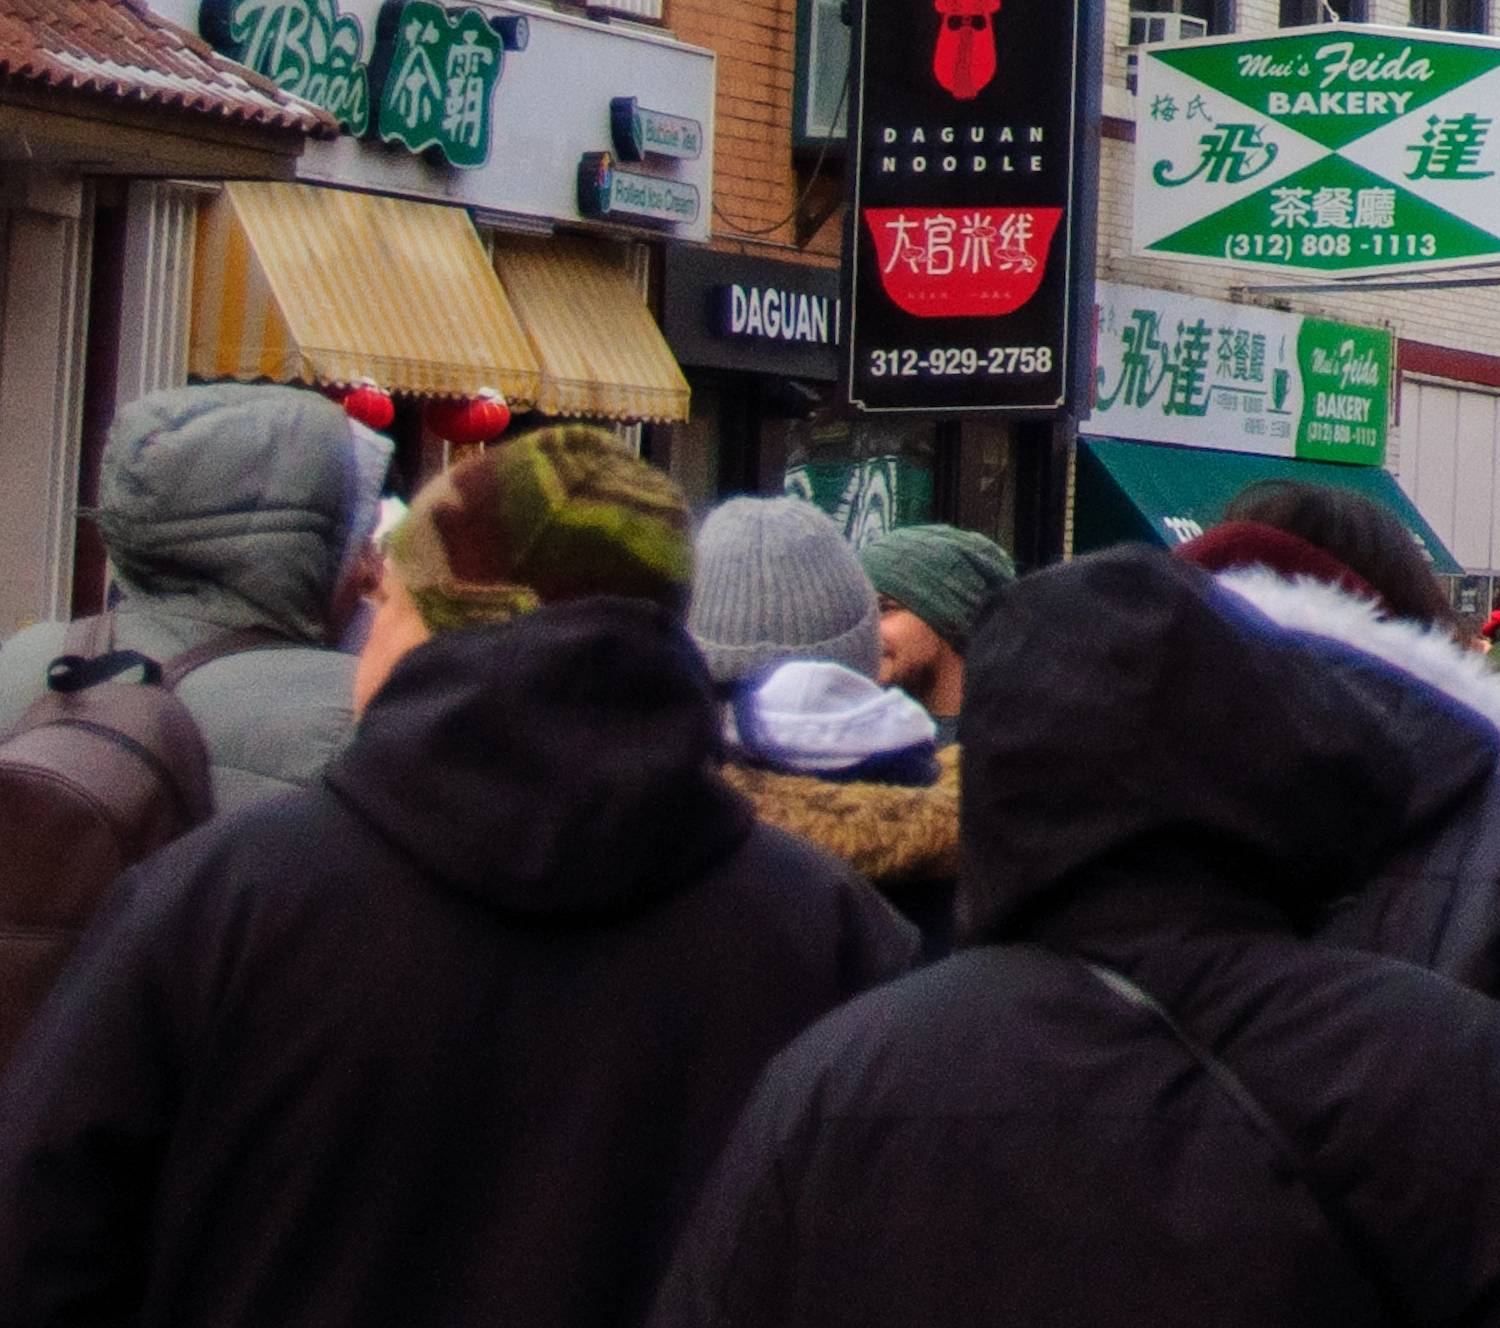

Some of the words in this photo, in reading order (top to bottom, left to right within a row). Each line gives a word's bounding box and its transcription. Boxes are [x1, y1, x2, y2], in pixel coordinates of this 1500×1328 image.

[388, 17, 494, 144] 茶霸
[1236, 52, 1311, 79] Mui's
[1314, 41, 1436, 89] Feida
[1267, 90, 1413, 116] BAKERY
[883, 126, 1044, 143] DAGUAN
[1403, 112, 1495, 181] 達
[882, 155, 1043, 172] NOODLE
[1270, 186, 1397, 230] 茶餐廳
[884, 213, 1038, 275] 大官米线
[1224, 233, 1293, 260] (312)
[1300, 234, 1351, 256] 808
[1360, 233, 1436, 256] -1113
[731, 283, 828, 344] DAGUAN
[870, 346, 1052, 377] 312-929-2758
[1315, 392, 1372, 423] BAKERY
